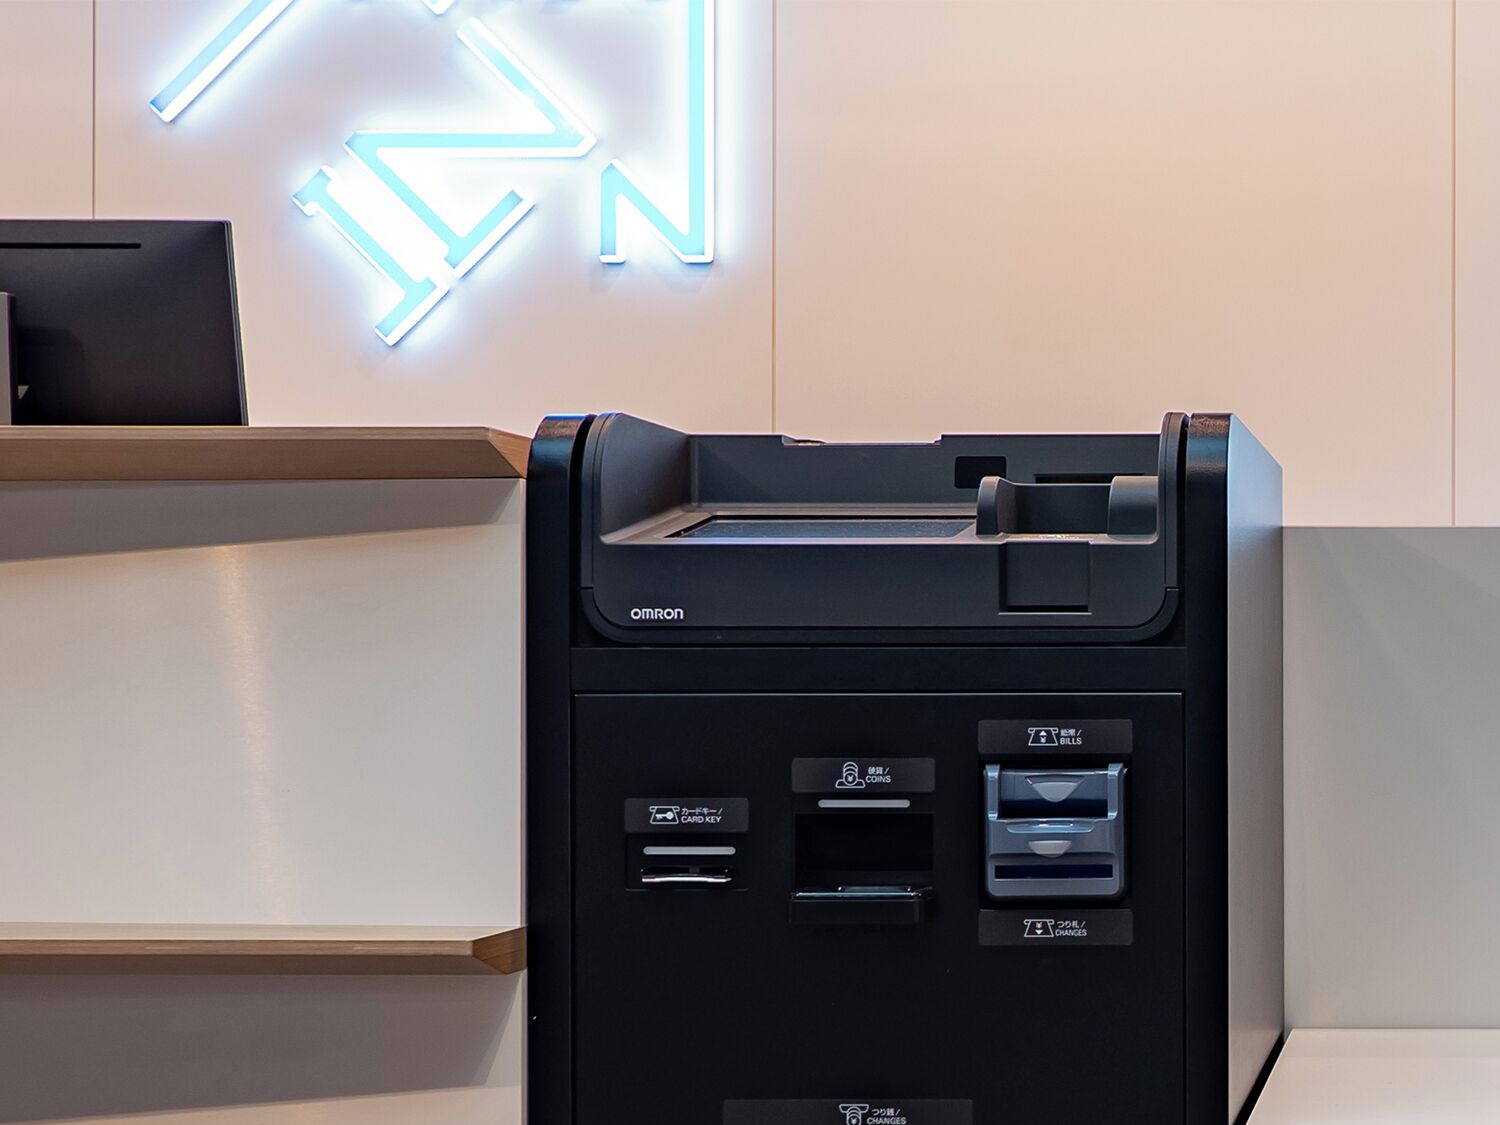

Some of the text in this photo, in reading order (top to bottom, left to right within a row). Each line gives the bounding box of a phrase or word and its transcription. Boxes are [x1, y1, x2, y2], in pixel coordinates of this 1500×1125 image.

[631, 608, 684, 619] OMRON
[1060, 737, 1082, 745] BILLS
[865, 775, 891, 783] COINS
[1055, 929, 1087, 937] CHANGES
[866, 1117, 907, 1125] CHANGES
